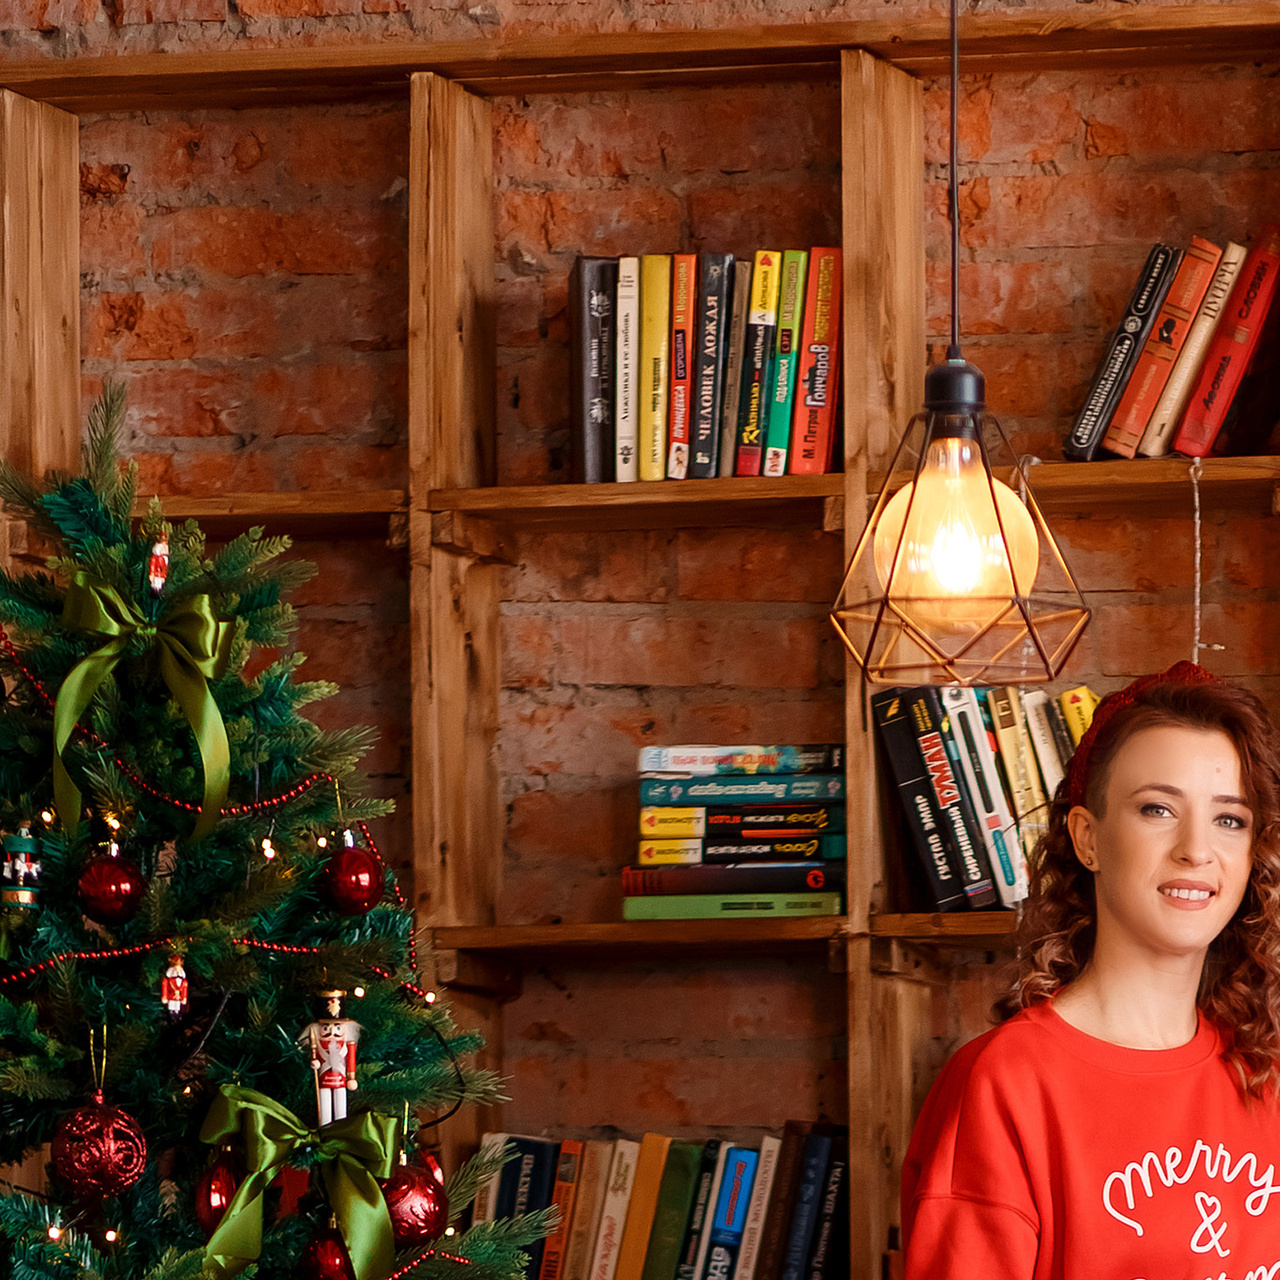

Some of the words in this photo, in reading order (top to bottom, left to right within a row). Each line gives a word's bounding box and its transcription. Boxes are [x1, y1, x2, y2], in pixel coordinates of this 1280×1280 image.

[676, 262, 687, 310] Воронцова
[758, 270, 771, 309] Донцова
[1201, 258, 1238, 320] ЦУСИМА
[702, 295, 718, 357] ДОЖДЯ
[1202, 355, 1232, 412] Леонид
[1238, 260, 1270, 320] СЛОВИН
[620, 372, 630, 422] Анжелика
[698, 364, 715, 440] ЧЕЛОВЕК
[804, 344, 830, 406] Гончаров
[673, 385, 686, 438] ПРИНЦЕССА
[804, 408, 819, 443] Петров
[803, 444, 814, 458] М.
[917, 732, 962, 810] ТУМАН
[948, 806, 981, 880] СИРЕНЕВЫЙ
[750, 1149, 774, 1224] молодости
[824, 1168, 842, 1214] ШАХТА
[1190, 1191, 1230, 1258] &
